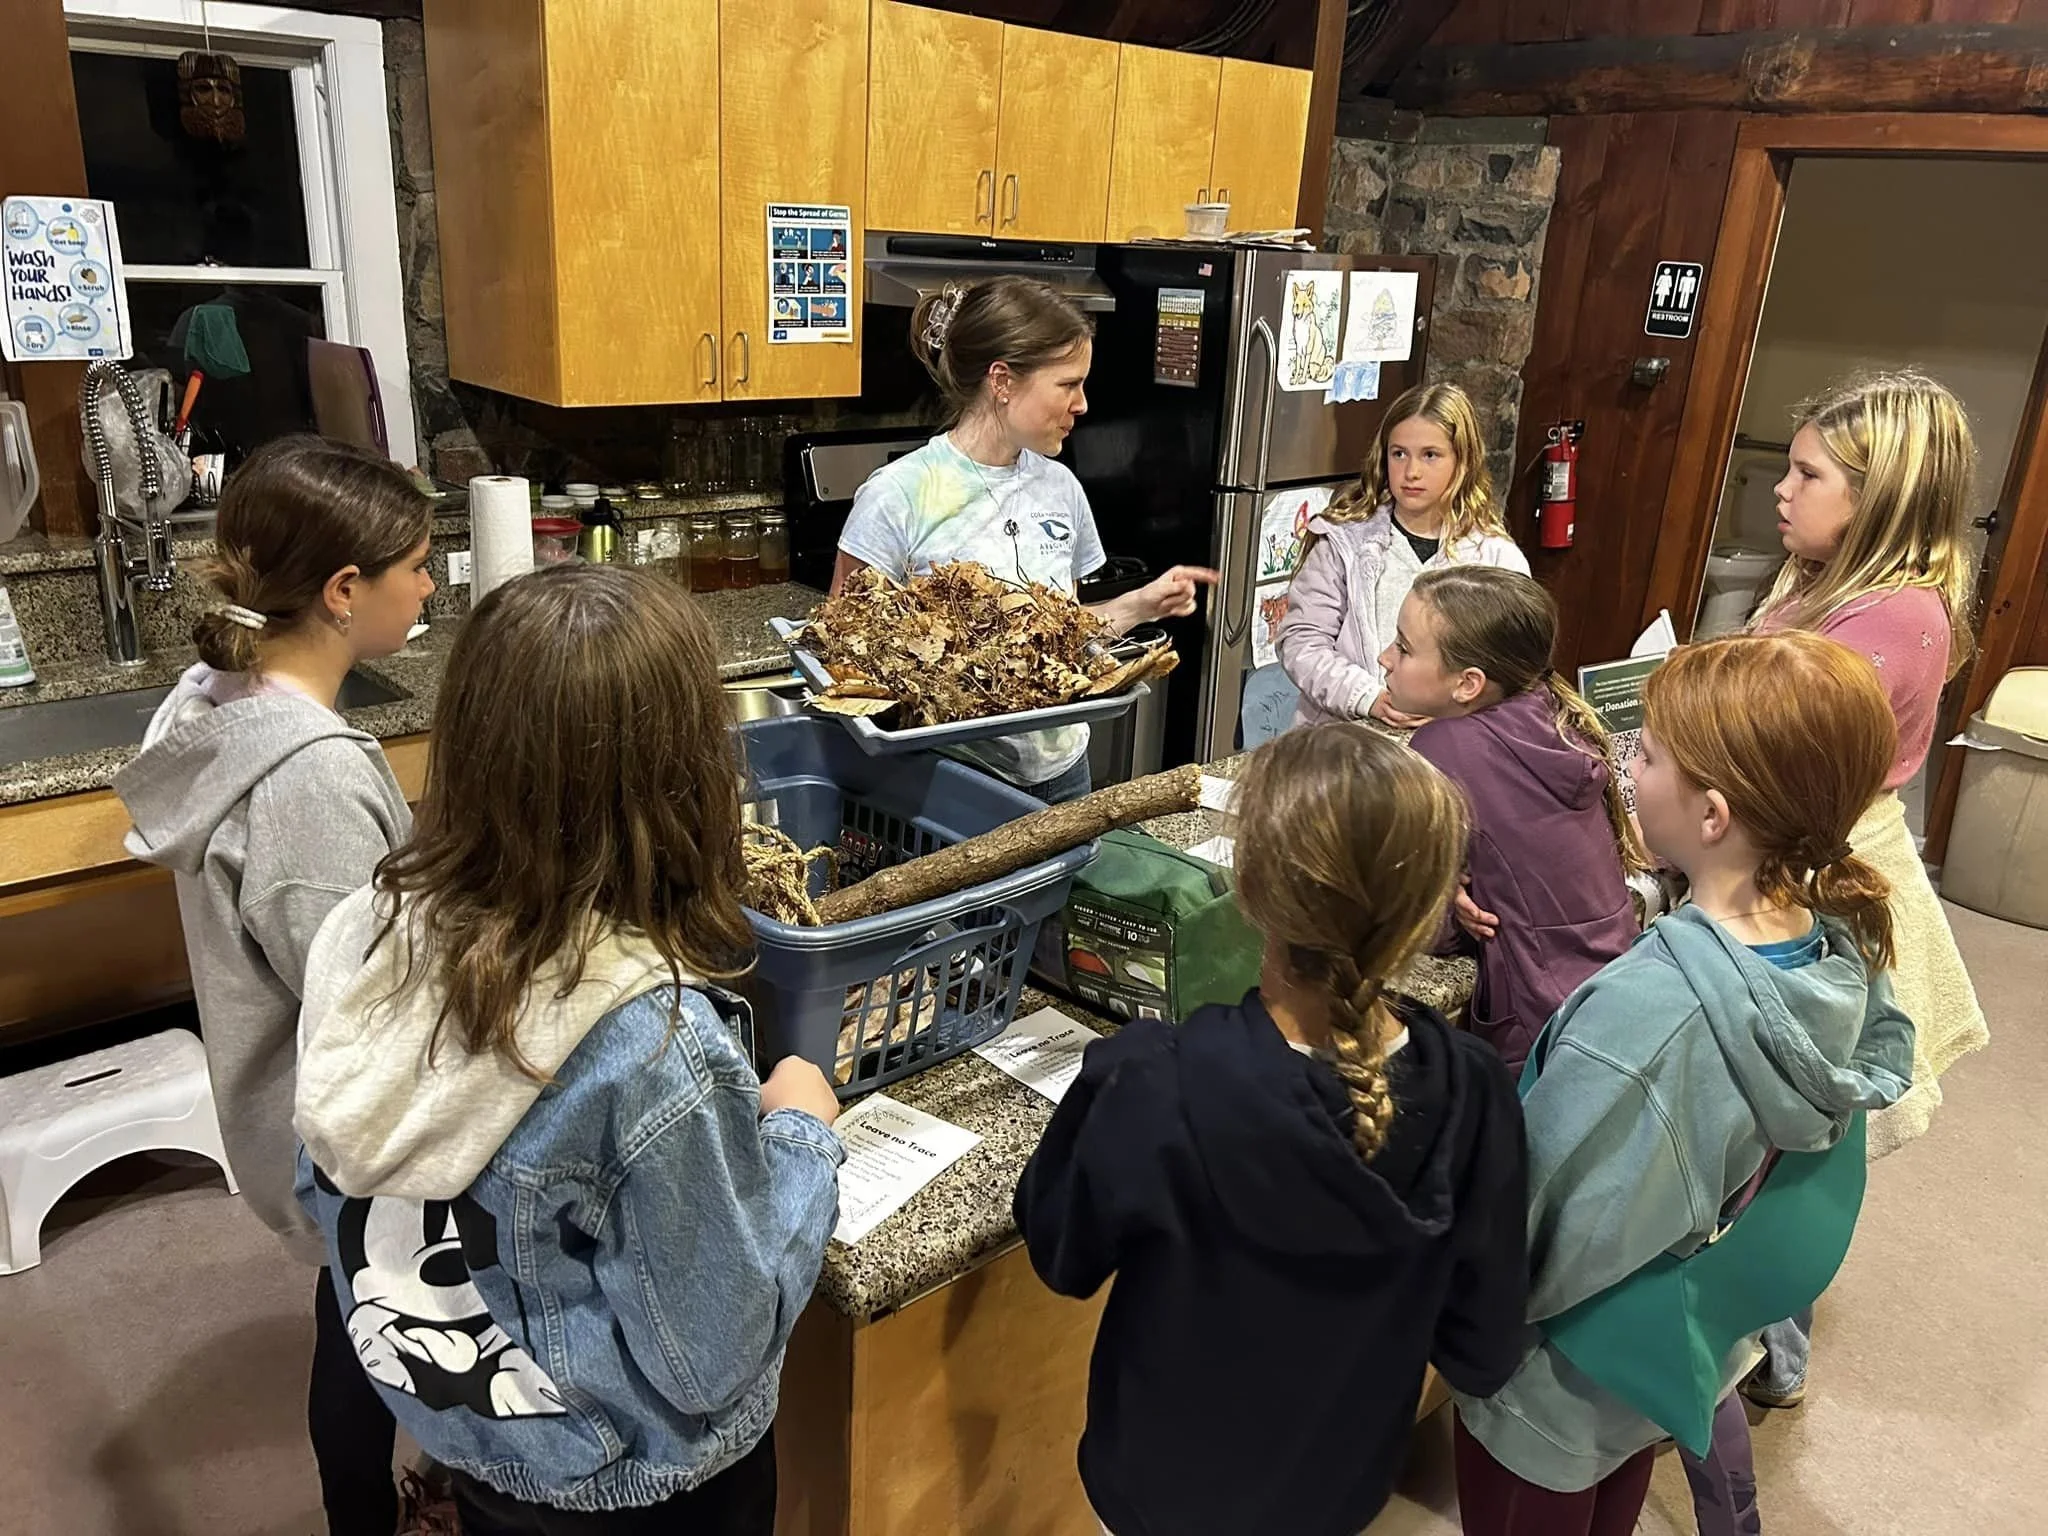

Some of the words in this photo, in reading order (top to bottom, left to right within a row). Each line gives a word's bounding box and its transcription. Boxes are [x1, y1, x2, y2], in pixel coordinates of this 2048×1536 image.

[773, 208, 786, 216] Stop
[788, 208, 798, 216] the
[799, 209, 820, 217] Spread
[10, 267, 50, 284] YOUR
[1652, 312, 1689, 322] RESTROOM
[1605, 698, 1638, 712] Donation
[1127, 930, 1138, 941] 10
[1008, 1046, 1038, 1058] Leave
[1038, 1040, 1050, 1048] no
[1048, 1028, 1075, 1042] Trace
[860, 1120, 890, 1138] Leave
[891, 1136, 906, 1145] no
[908, 1141, 936, 1158] Trace
